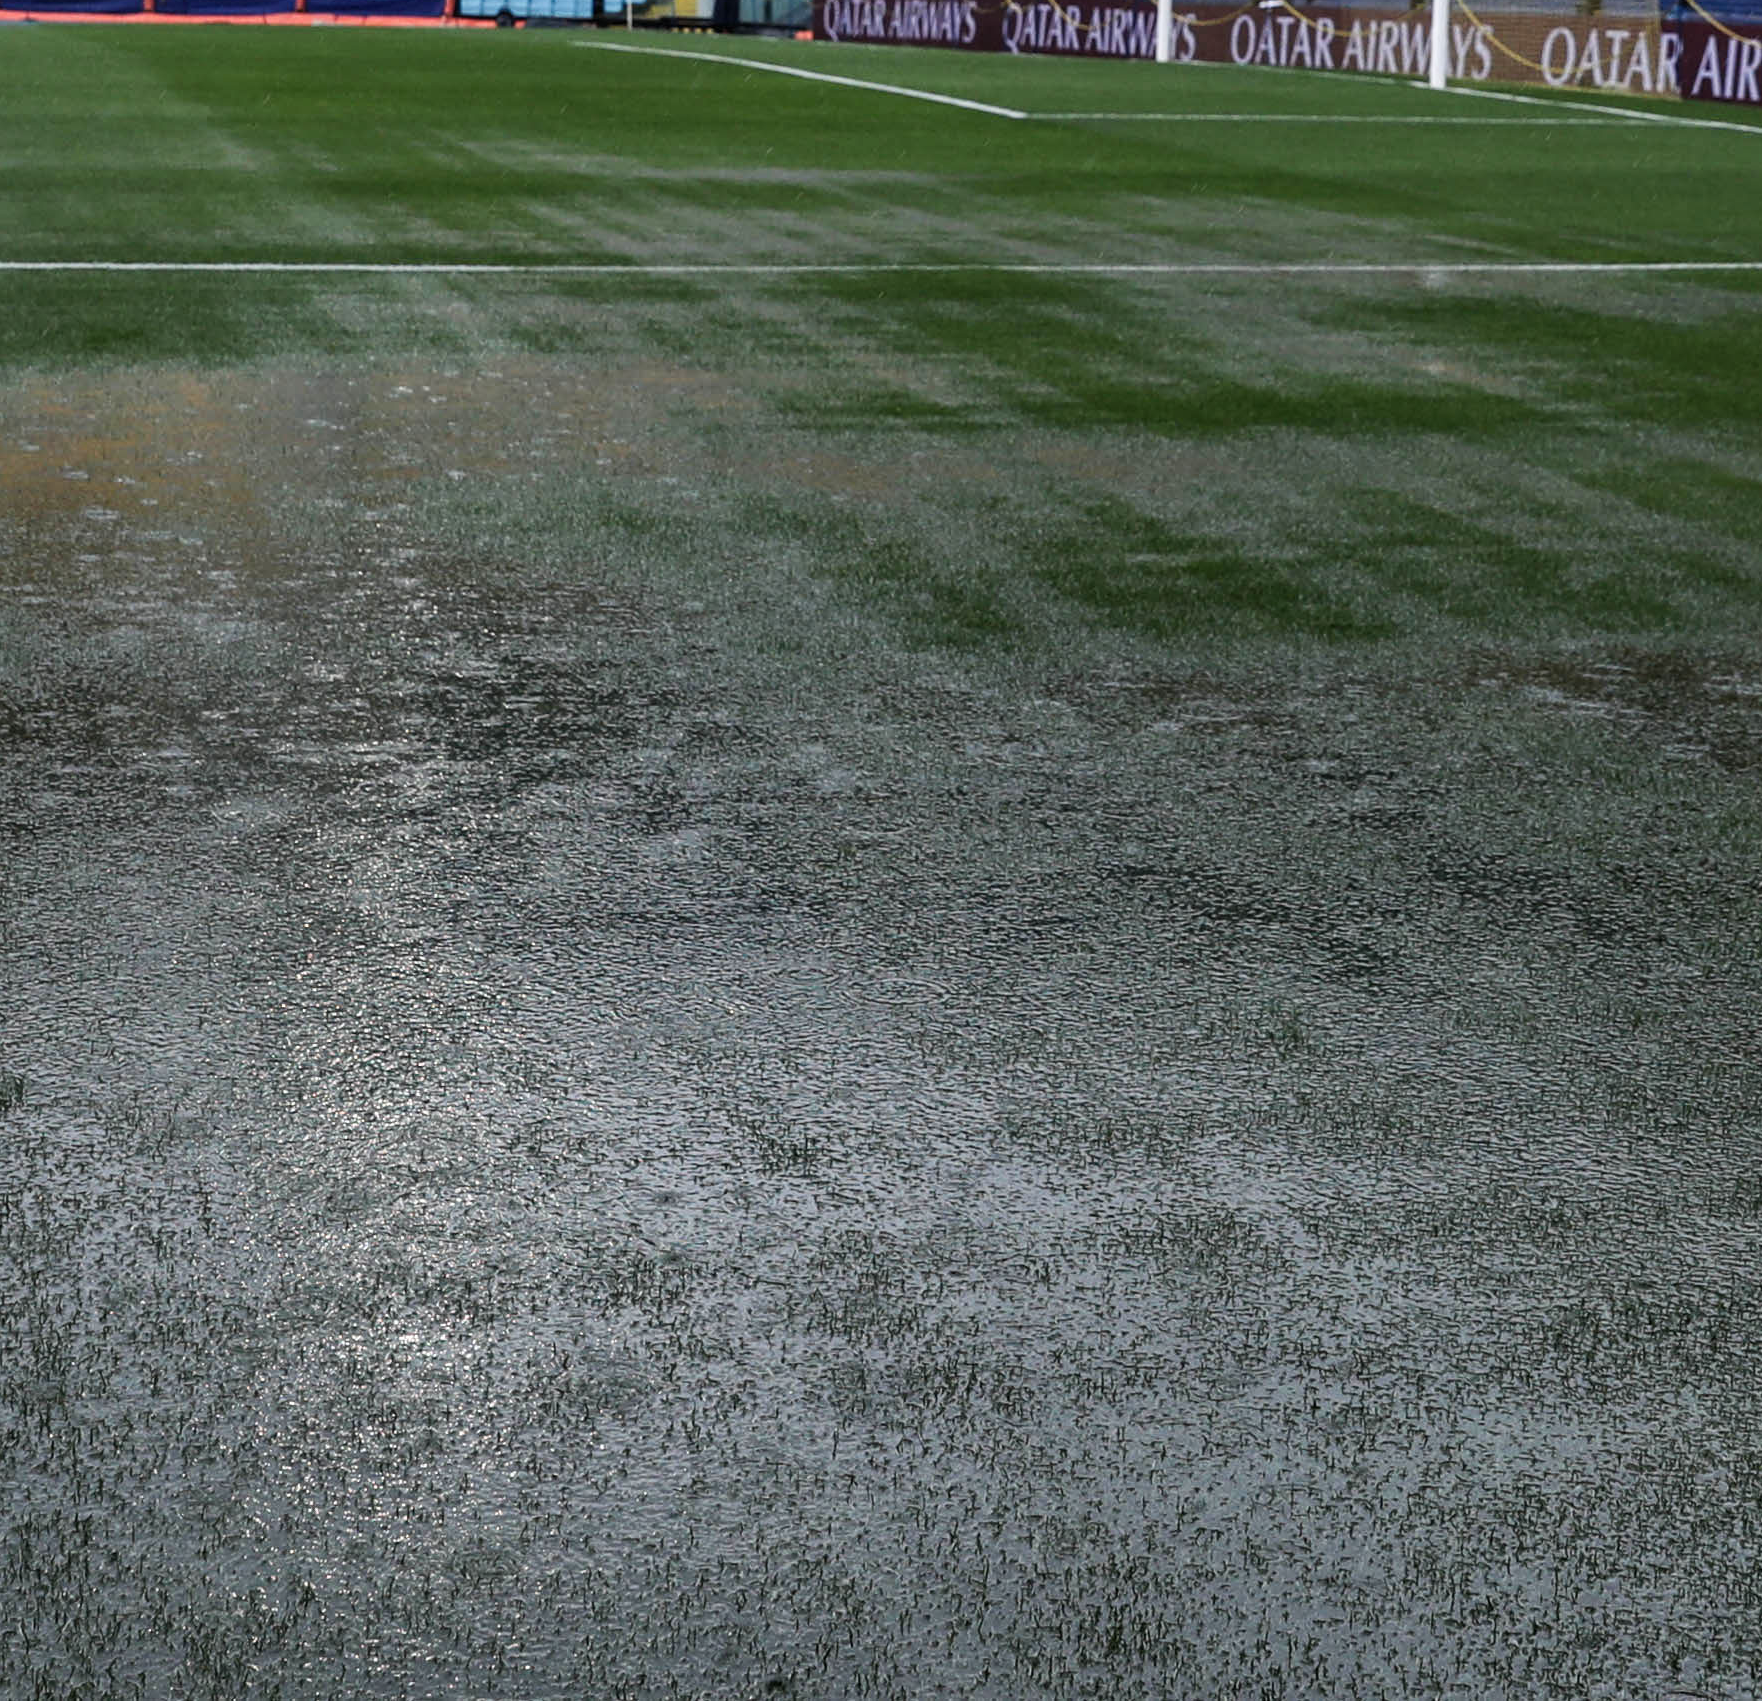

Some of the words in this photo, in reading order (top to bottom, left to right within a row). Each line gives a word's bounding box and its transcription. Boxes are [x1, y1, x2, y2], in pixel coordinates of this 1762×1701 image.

[1002, 0, 1080, 55] QATAR
[1084, 7, 1198, 62] AIRWYS
[1342, 18, 1494, 80] AIRWYS
[1540, 26, 1683, 94] QATAR
